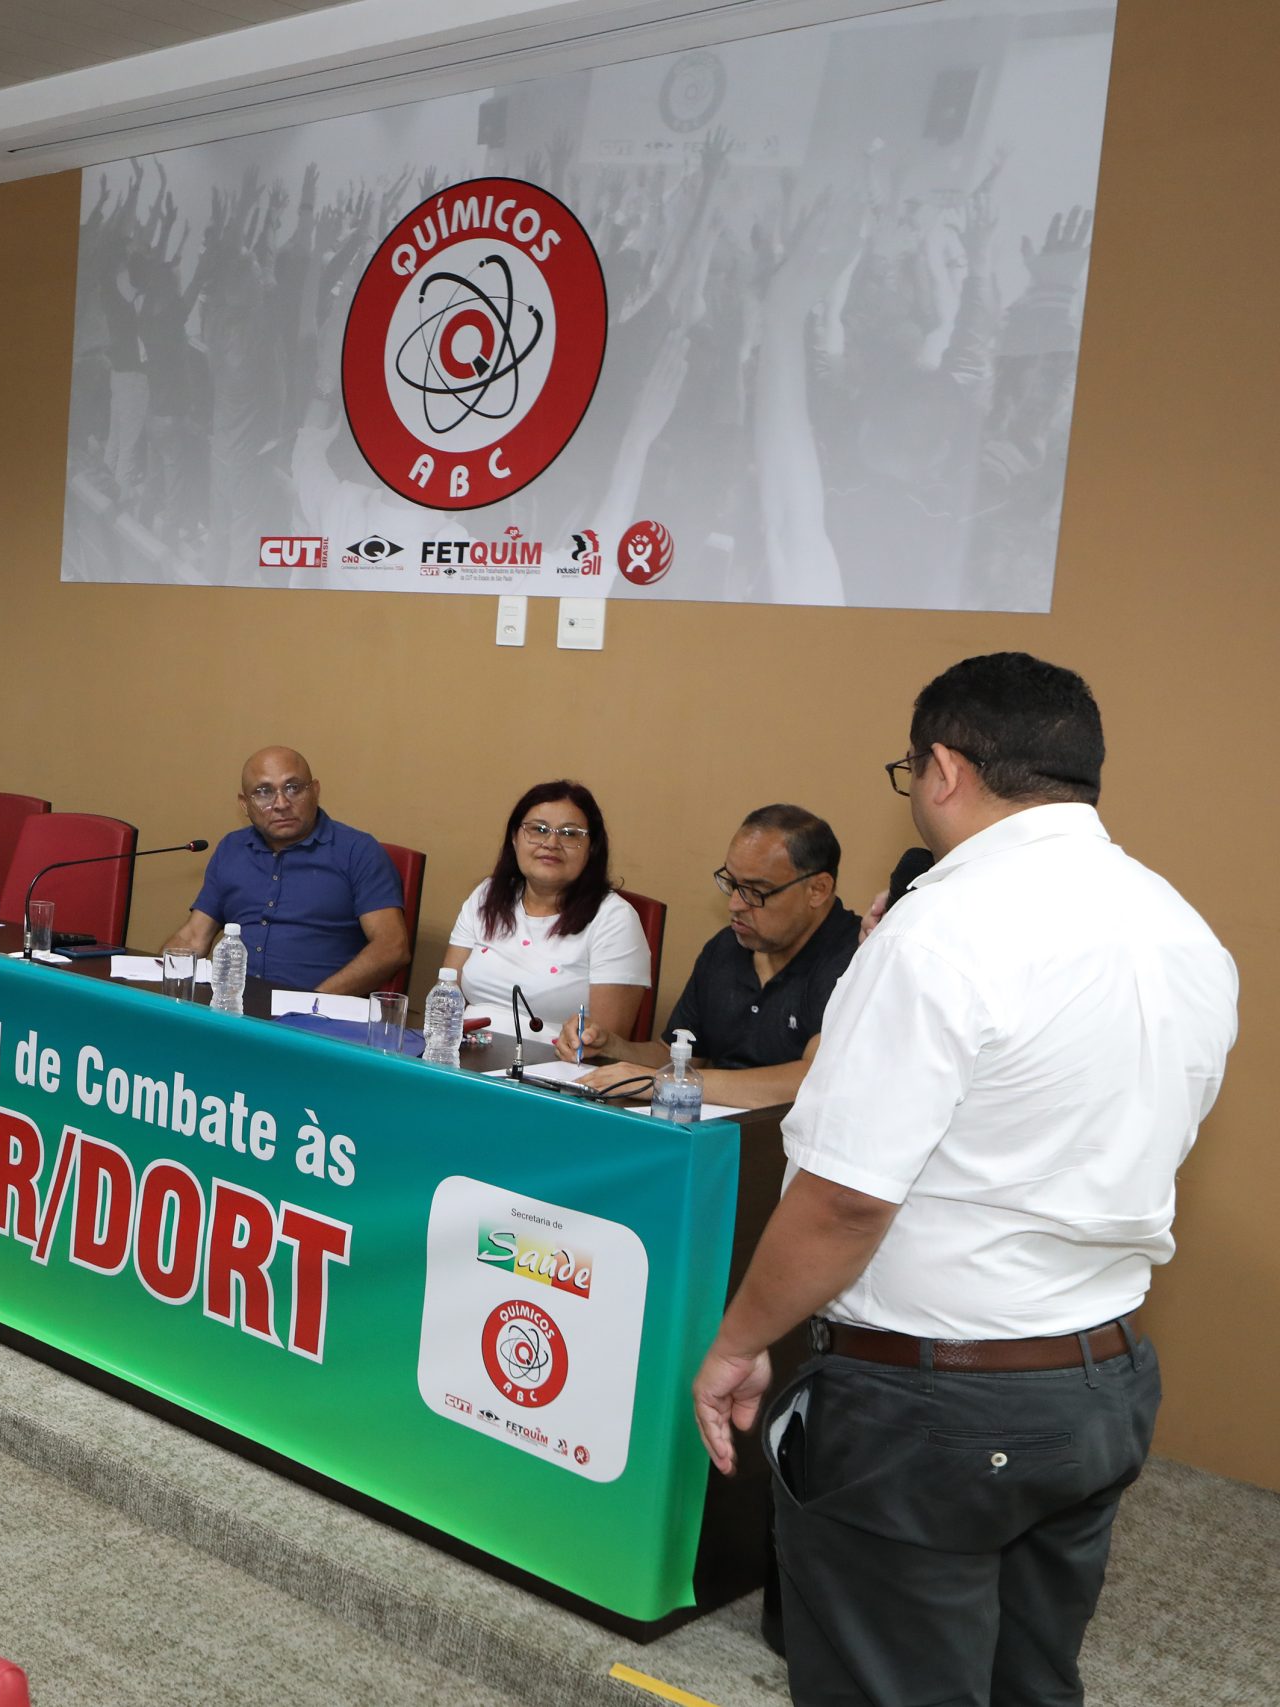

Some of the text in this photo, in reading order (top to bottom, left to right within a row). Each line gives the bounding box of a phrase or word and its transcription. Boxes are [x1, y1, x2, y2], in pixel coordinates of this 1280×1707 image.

[391, 195, 562, 276] QUÍMICOS
[260, 539, 321, 566] CUT
[321, 537, 329, 568] BRASIL
[342, 556, 360, 564] CNQ
[421, 541, 543, 566] FETQUIM
[15, 1030, 61, 1093] de
[76, 1045, 277, 1161] Combate
[295, 1107, 356, 1187] às
[511, 1208, 563, 1230] Secretaria de
[477, 1231, 590, 1289] Saúde
[500, 1301, 555, 1339] QUÍMICOS
[445, 1395, 471, 1413] CUT
